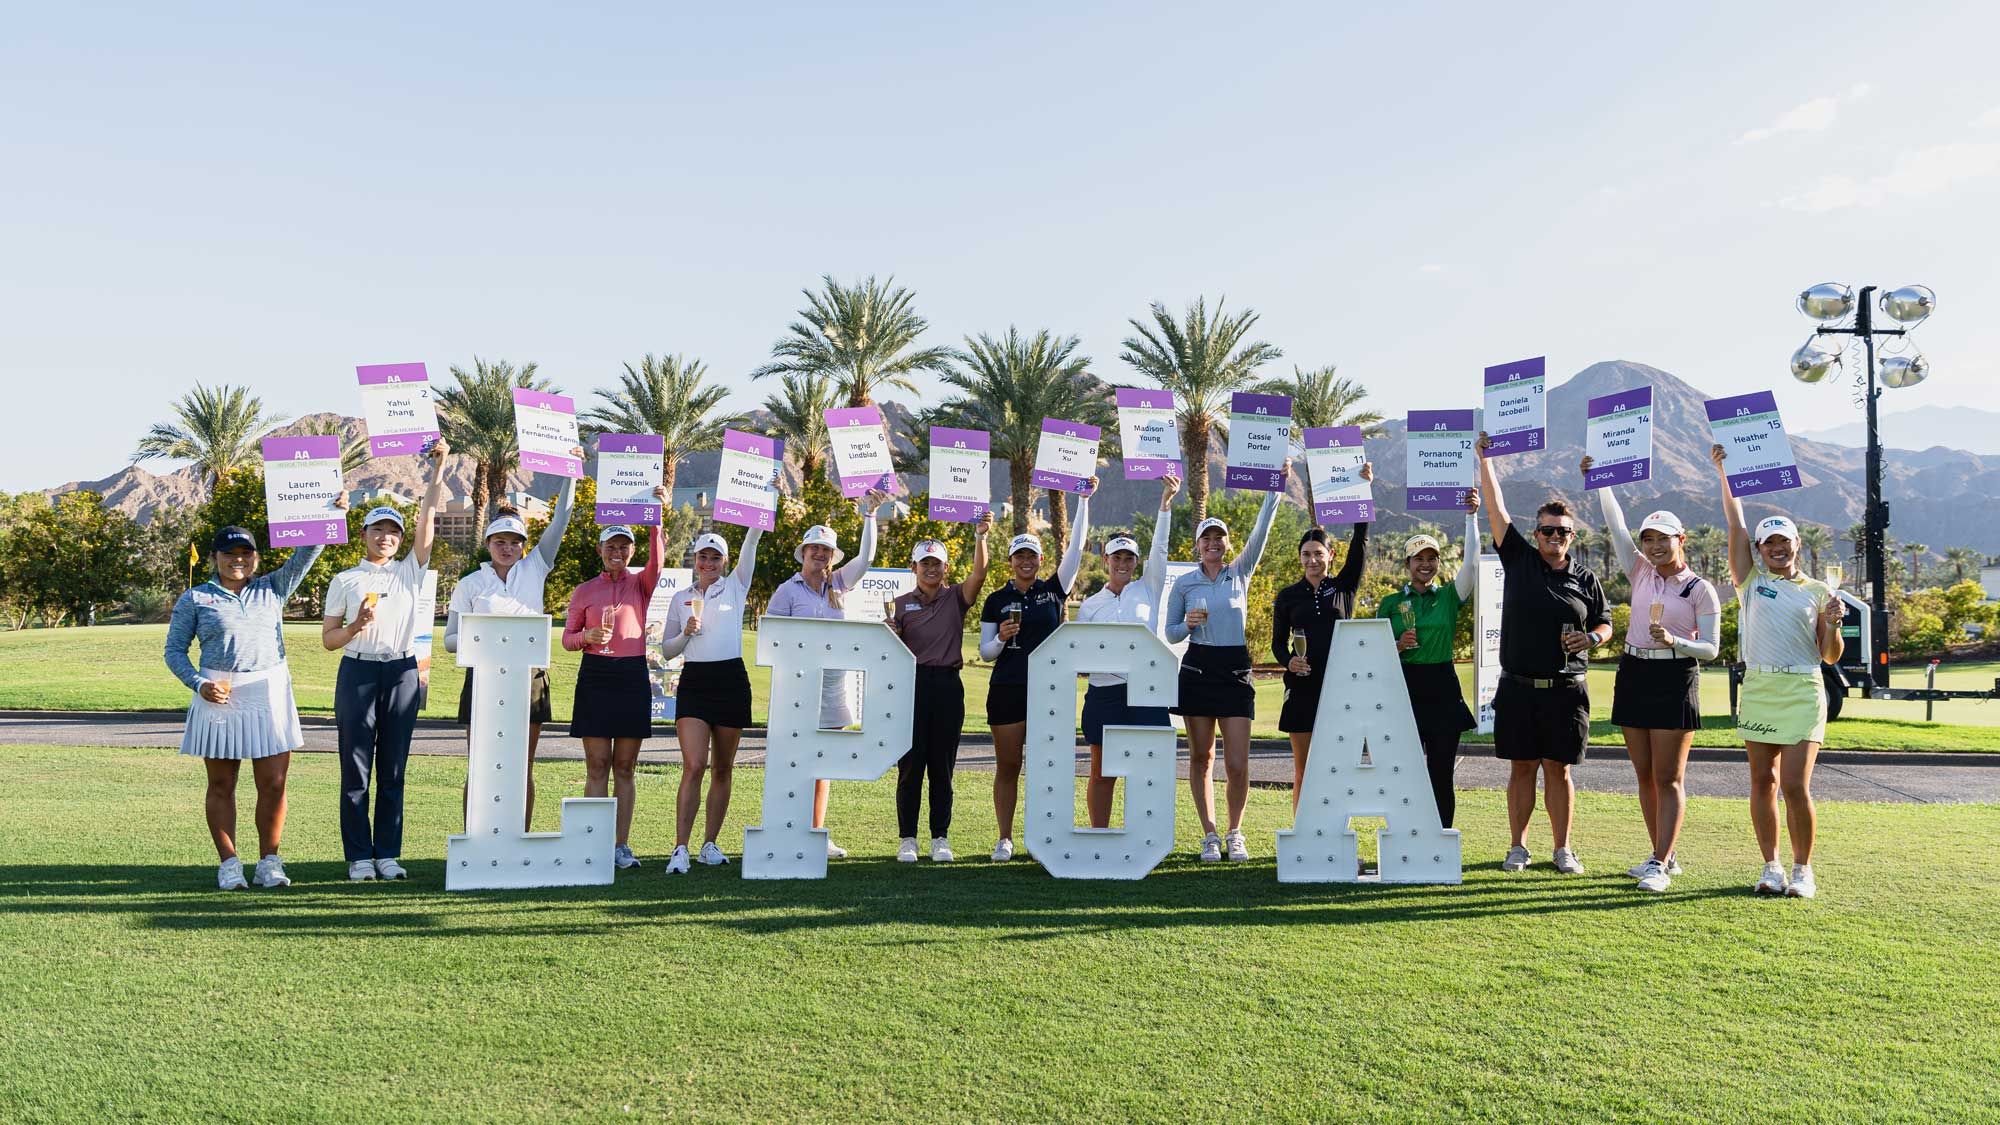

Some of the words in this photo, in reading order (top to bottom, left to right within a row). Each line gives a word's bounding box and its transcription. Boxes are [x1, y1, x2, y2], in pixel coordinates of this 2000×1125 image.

[1509, 373, 1520, 381] AA
[1533, 385, 1543, 394] 13
[387, 399, 410, 407] Yahui
[1501, 397, 1528, 407] Daniela
[1499, 406, 1529, 416] Iacobelli
[1614, 404, 1625, 412] AA
[1736, 408, 1750, 416] AA
[1638, 415, 1648, 424] 14
[1767, 420, 1780, 429] 15
[1277, 428, 1288, 436] 10
[1603, 428, 1635, 438] Miranda
[1140, 435, 1161, 443] Young
[1607, 438, 1630, 447] Wang
[1734, 433, 1768, 443] Heather
[1460, 441, 1471, 449] 12
[295, 451, 310, 459] AA
[748, 447, 760, 455] AA
[526, 458, 550, 466] LPGA
[982, 461, 986, 469] 7
[333, 469, 338, 478] 1
[738, 469, 763, 480] Brooke
[773, 469, 778, 477] 5
[950, 466, 970, 475] Jenny
[1591, 472, 1615, 481] LPGA
[731, 478, 767, 491] Matthews
[1735, 479, 1762, 488] LPGA
[278, 493, 333, 501] Stephenson
[720, 507, 742, 516] LPGA
[1763, 519, 1788, 528] CTBC
[277, 530, 305, 538] LPGA
[862, 579, 899, 590] EPSON
[1486, 630, 1500, 640] EPS
